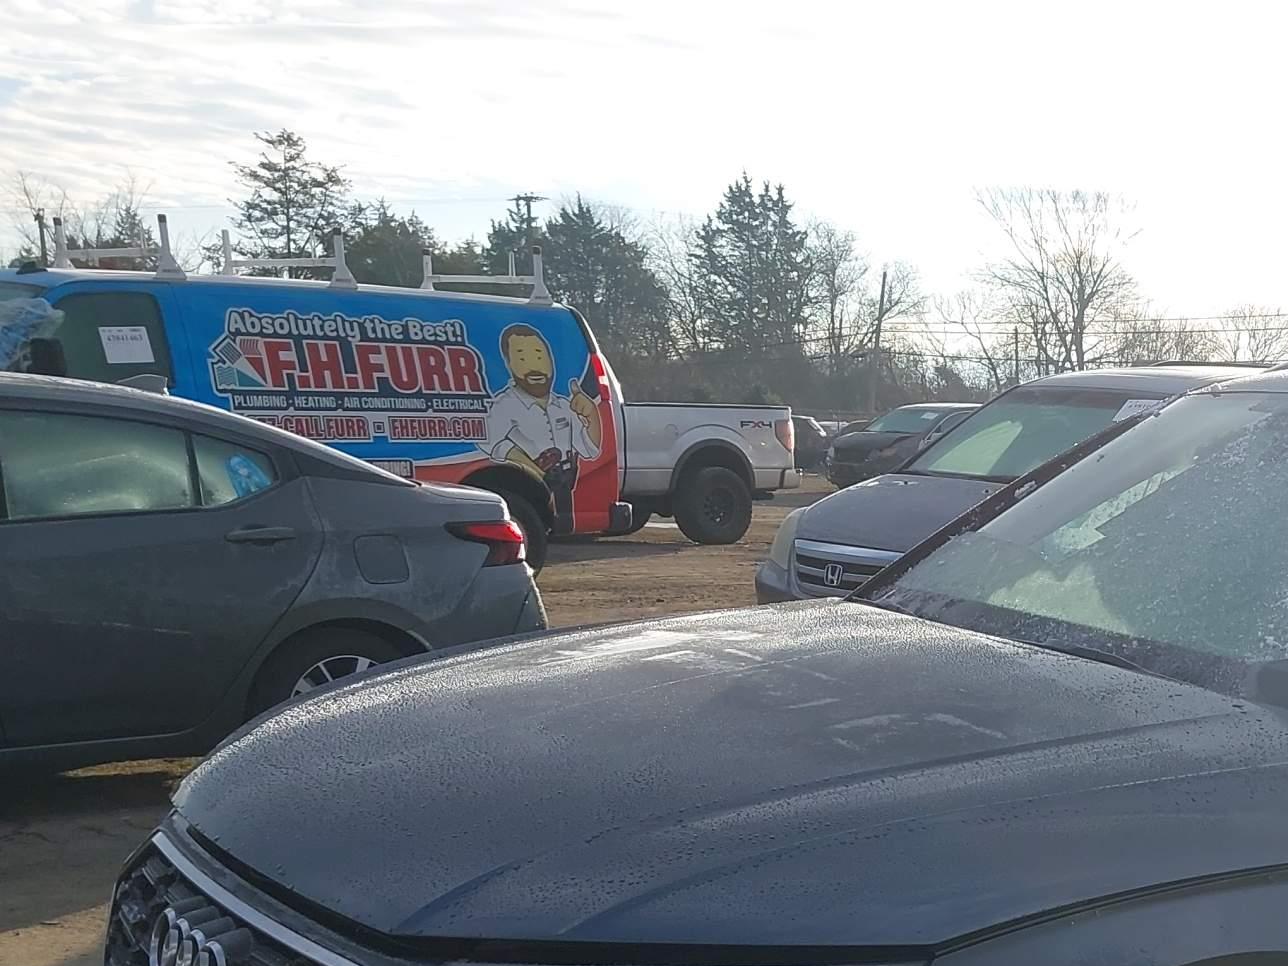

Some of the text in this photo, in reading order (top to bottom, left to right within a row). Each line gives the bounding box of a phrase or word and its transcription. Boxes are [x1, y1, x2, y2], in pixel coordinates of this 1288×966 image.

[229, 311, 462, 342] Absolutely the Best!
[262, 339, 485, 393] F.H.FURR
[234, 395, 485, 410] PLUMBING HEATING AIR CONDITIONING ELECTRICAL
[325, 417, 368, 438] FURR
[391, 418, 484, 438] FHFURR.COM
[741, 420, 772, 429] FX4
